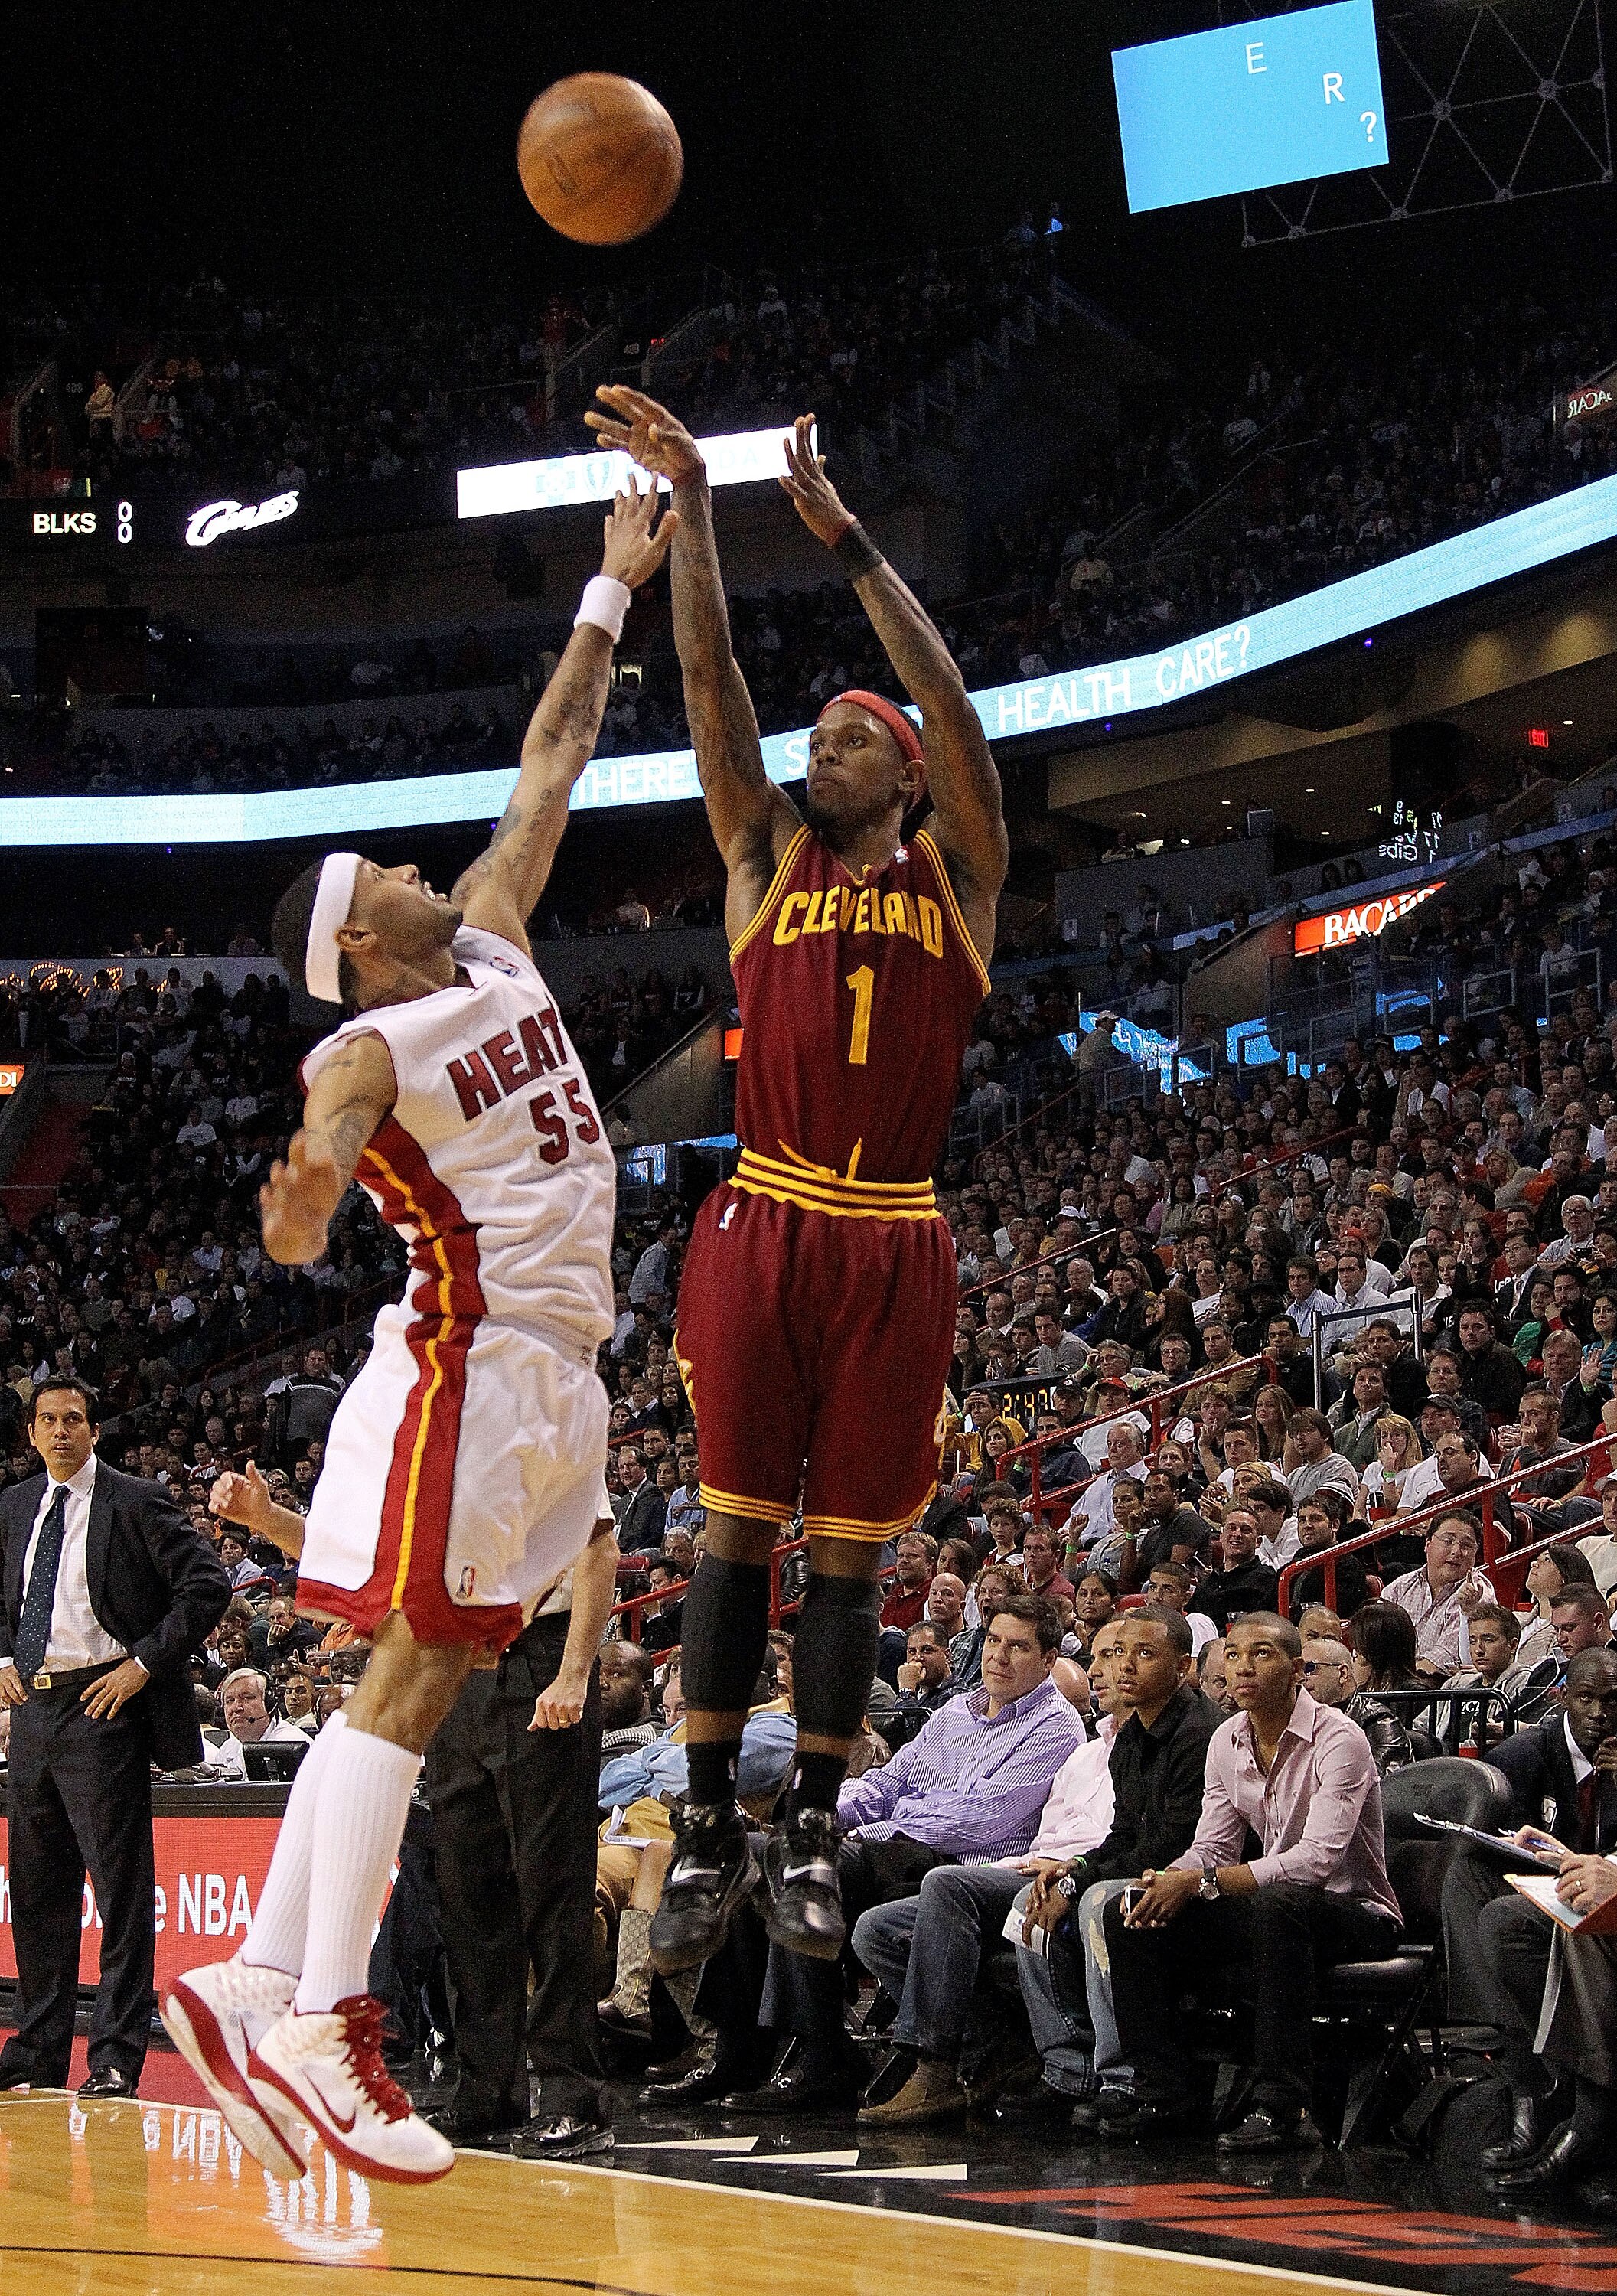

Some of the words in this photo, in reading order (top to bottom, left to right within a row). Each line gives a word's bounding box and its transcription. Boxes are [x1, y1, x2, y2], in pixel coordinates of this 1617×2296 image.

[1245, 41, 1267, 74] E
[1322, 71, 1345, 105] R
[1359, 110, 1377, 142] ?
[33, 512, 96, 534] BLKS
[117, 501, 132, 523] 0
[117, 522, 132, 544] 0
[579, 757, 689, 804] THERE
[997, 667, 1132, 732] HEALTH
[1156, 624, 1250, 697] CARE?
[772, 885, 944, 959] CLEVELAND
[846, 964, 875, 1065] 1
[445, 1007, 569, 1123] HEAT
[528, 1077, 600, 1165] 55
[178, 1872, 254, 1936] NBA
